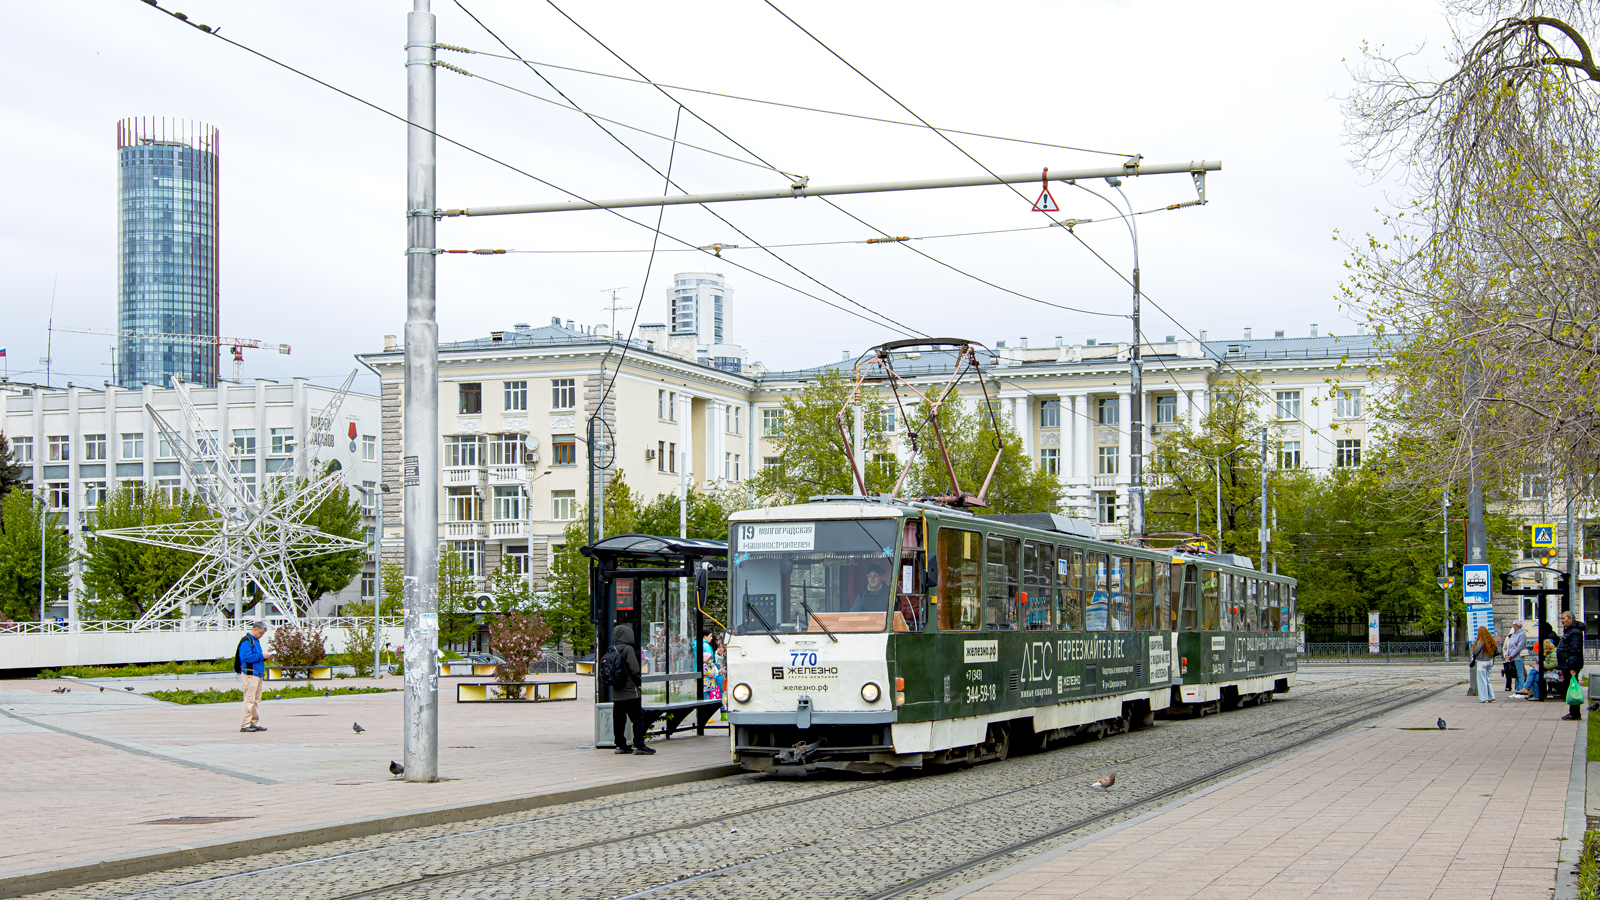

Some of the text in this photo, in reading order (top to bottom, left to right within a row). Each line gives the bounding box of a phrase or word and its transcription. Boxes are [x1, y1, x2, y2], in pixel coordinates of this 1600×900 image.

[742, 526, 755, 540] 19
[966, 643, 997, 660] железно.рф
[1057, 638, 1125, 661] ПЕРЕЕЗЖАЙТЕ В ЛЕС
[790, 653, 817, 666] 770
[1020, 641, 1053, 683] ЛЕС
[787, 667, 838, 675] ЖЕЛЕЗНО
[966, 669, 983, 682] +7 (343)
[783, 684, 829, 692] железно.рф
[966, 683, 997, 704] 344-59-18
